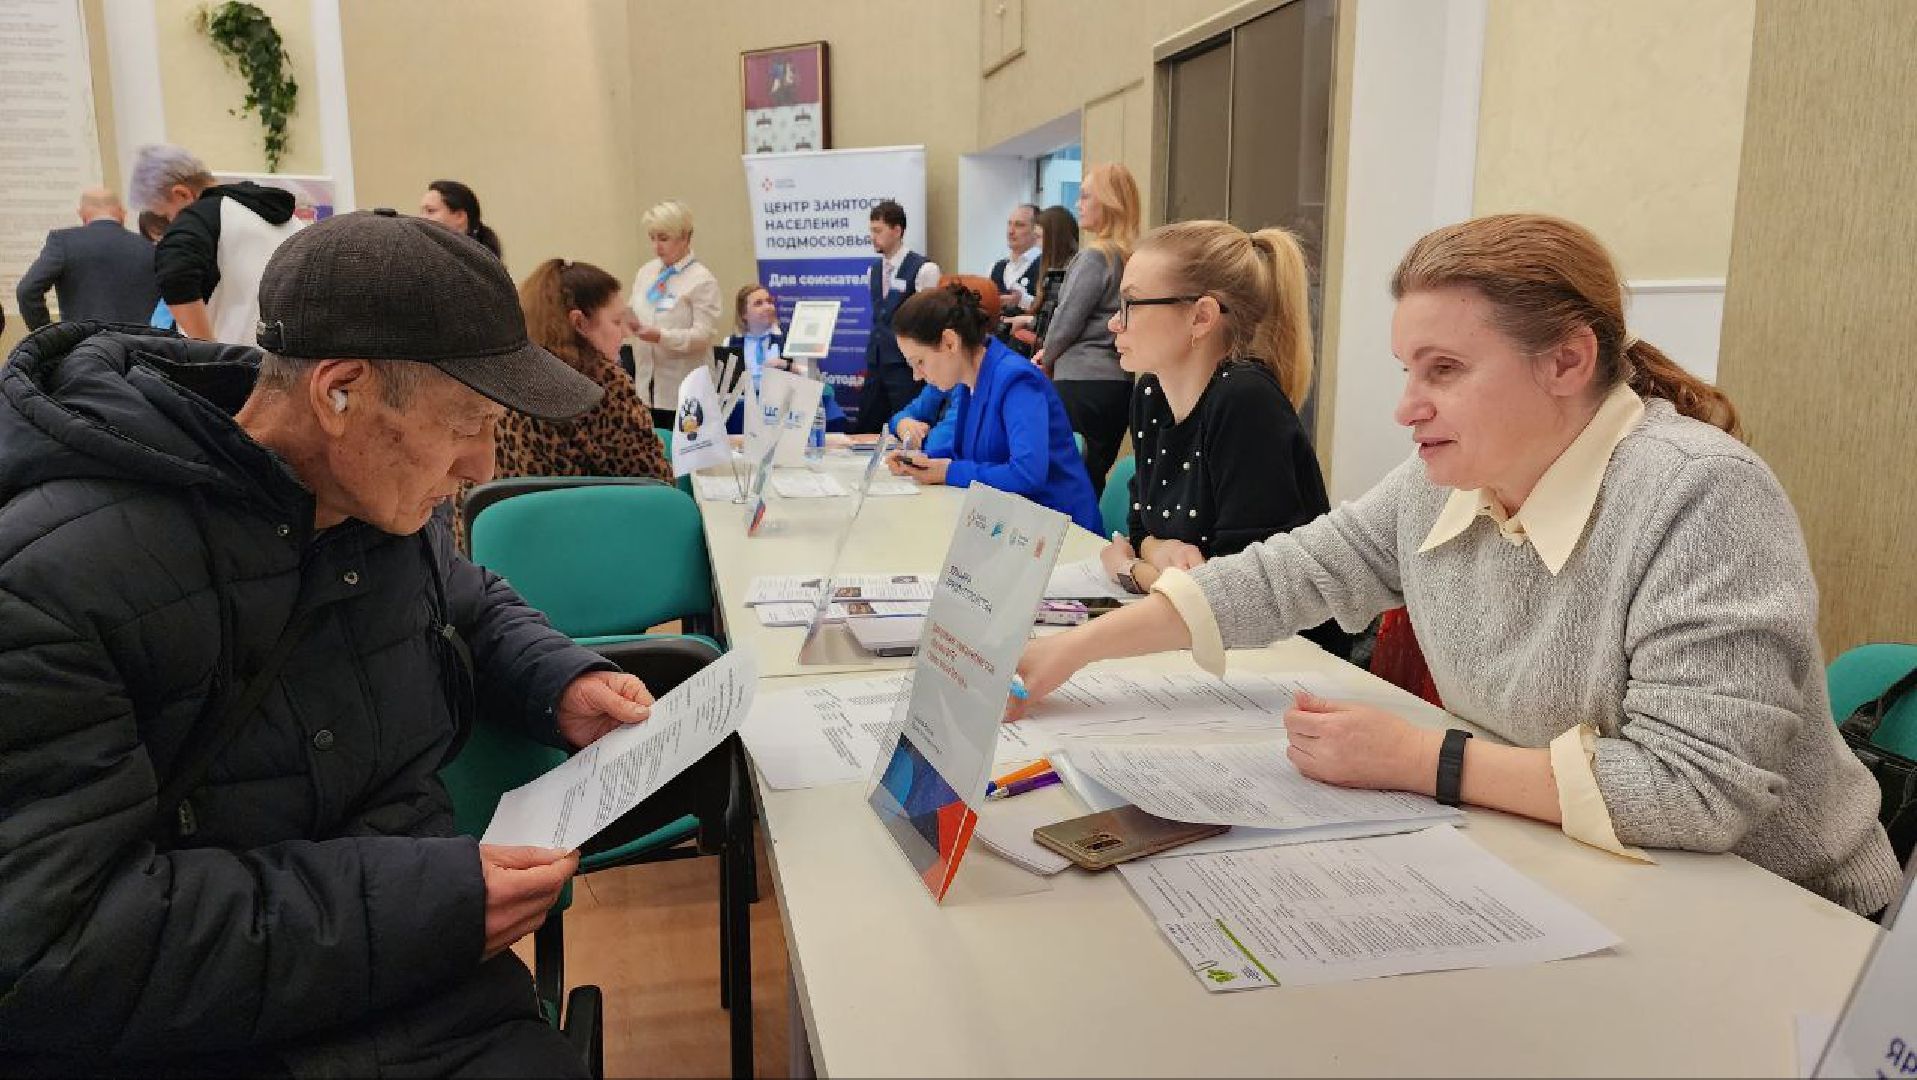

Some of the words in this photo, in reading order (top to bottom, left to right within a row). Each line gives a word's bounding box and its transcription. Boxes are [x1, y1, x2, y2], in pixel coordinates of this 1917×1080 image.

[764, 201, 809, 214] ЦЕНТР
[814, 197, 896, 212] ЗАНЯТОС
[765, 217, 850, 230] НАСЕЛЕНИЯ
[767, 234, 872, 249] ПОДМОСКОВЬЯ
[768, 273, 796, 287] Для
[799, 274, 869, 286] соискател
